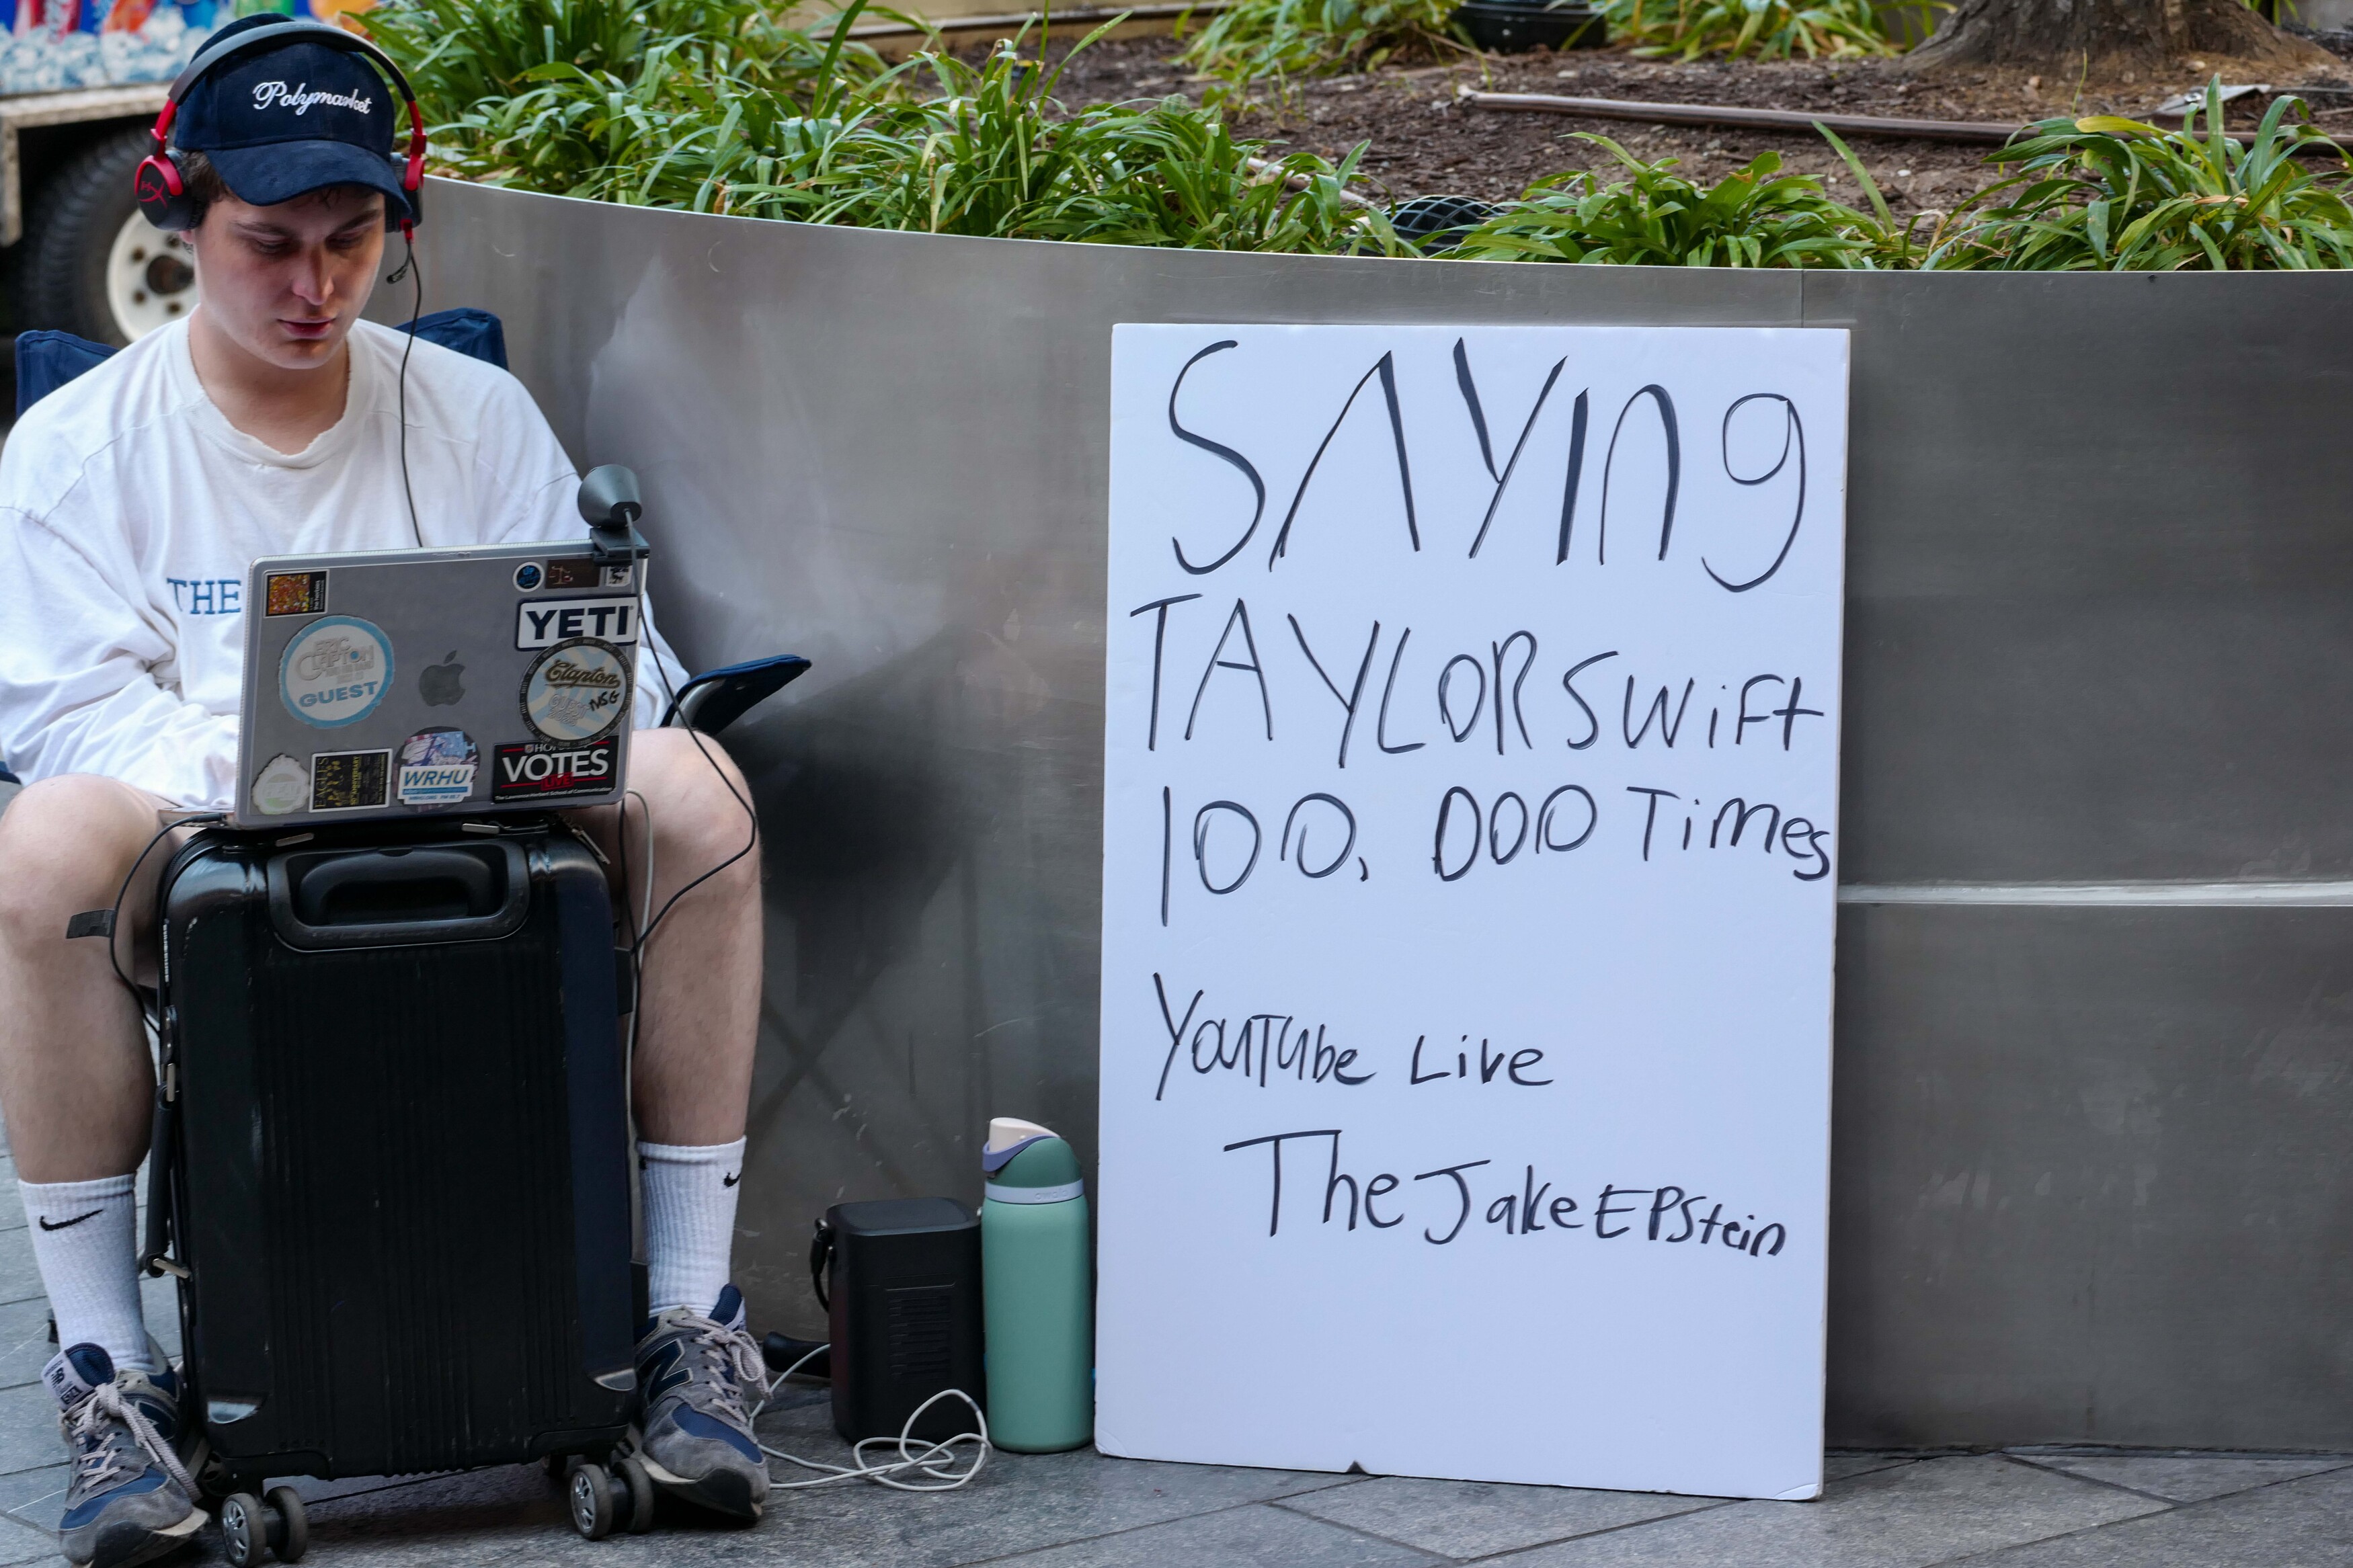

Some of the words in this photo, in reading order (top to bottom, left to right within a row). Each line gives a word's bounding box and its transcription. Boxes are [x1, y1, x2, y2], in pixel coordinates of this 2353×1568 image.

[252, 81, 373, 116] Polymarket
[166, 577, 241, 615] THE
[526, 606, 629, 640] YETI
[545, 659, 621, 690] Clapton
[1130, 594, 1538, 769] TAYLOR
[299, 681, 378, 708] GUEST
[314, 757, 329, 808] EAGLES
[403, 769, 470, 786] WRHU
[502, 749, 610, 782] VOTES
[545, 774, 571, 787] LIVE
[1410, 1036, 1554, 1086] Live
